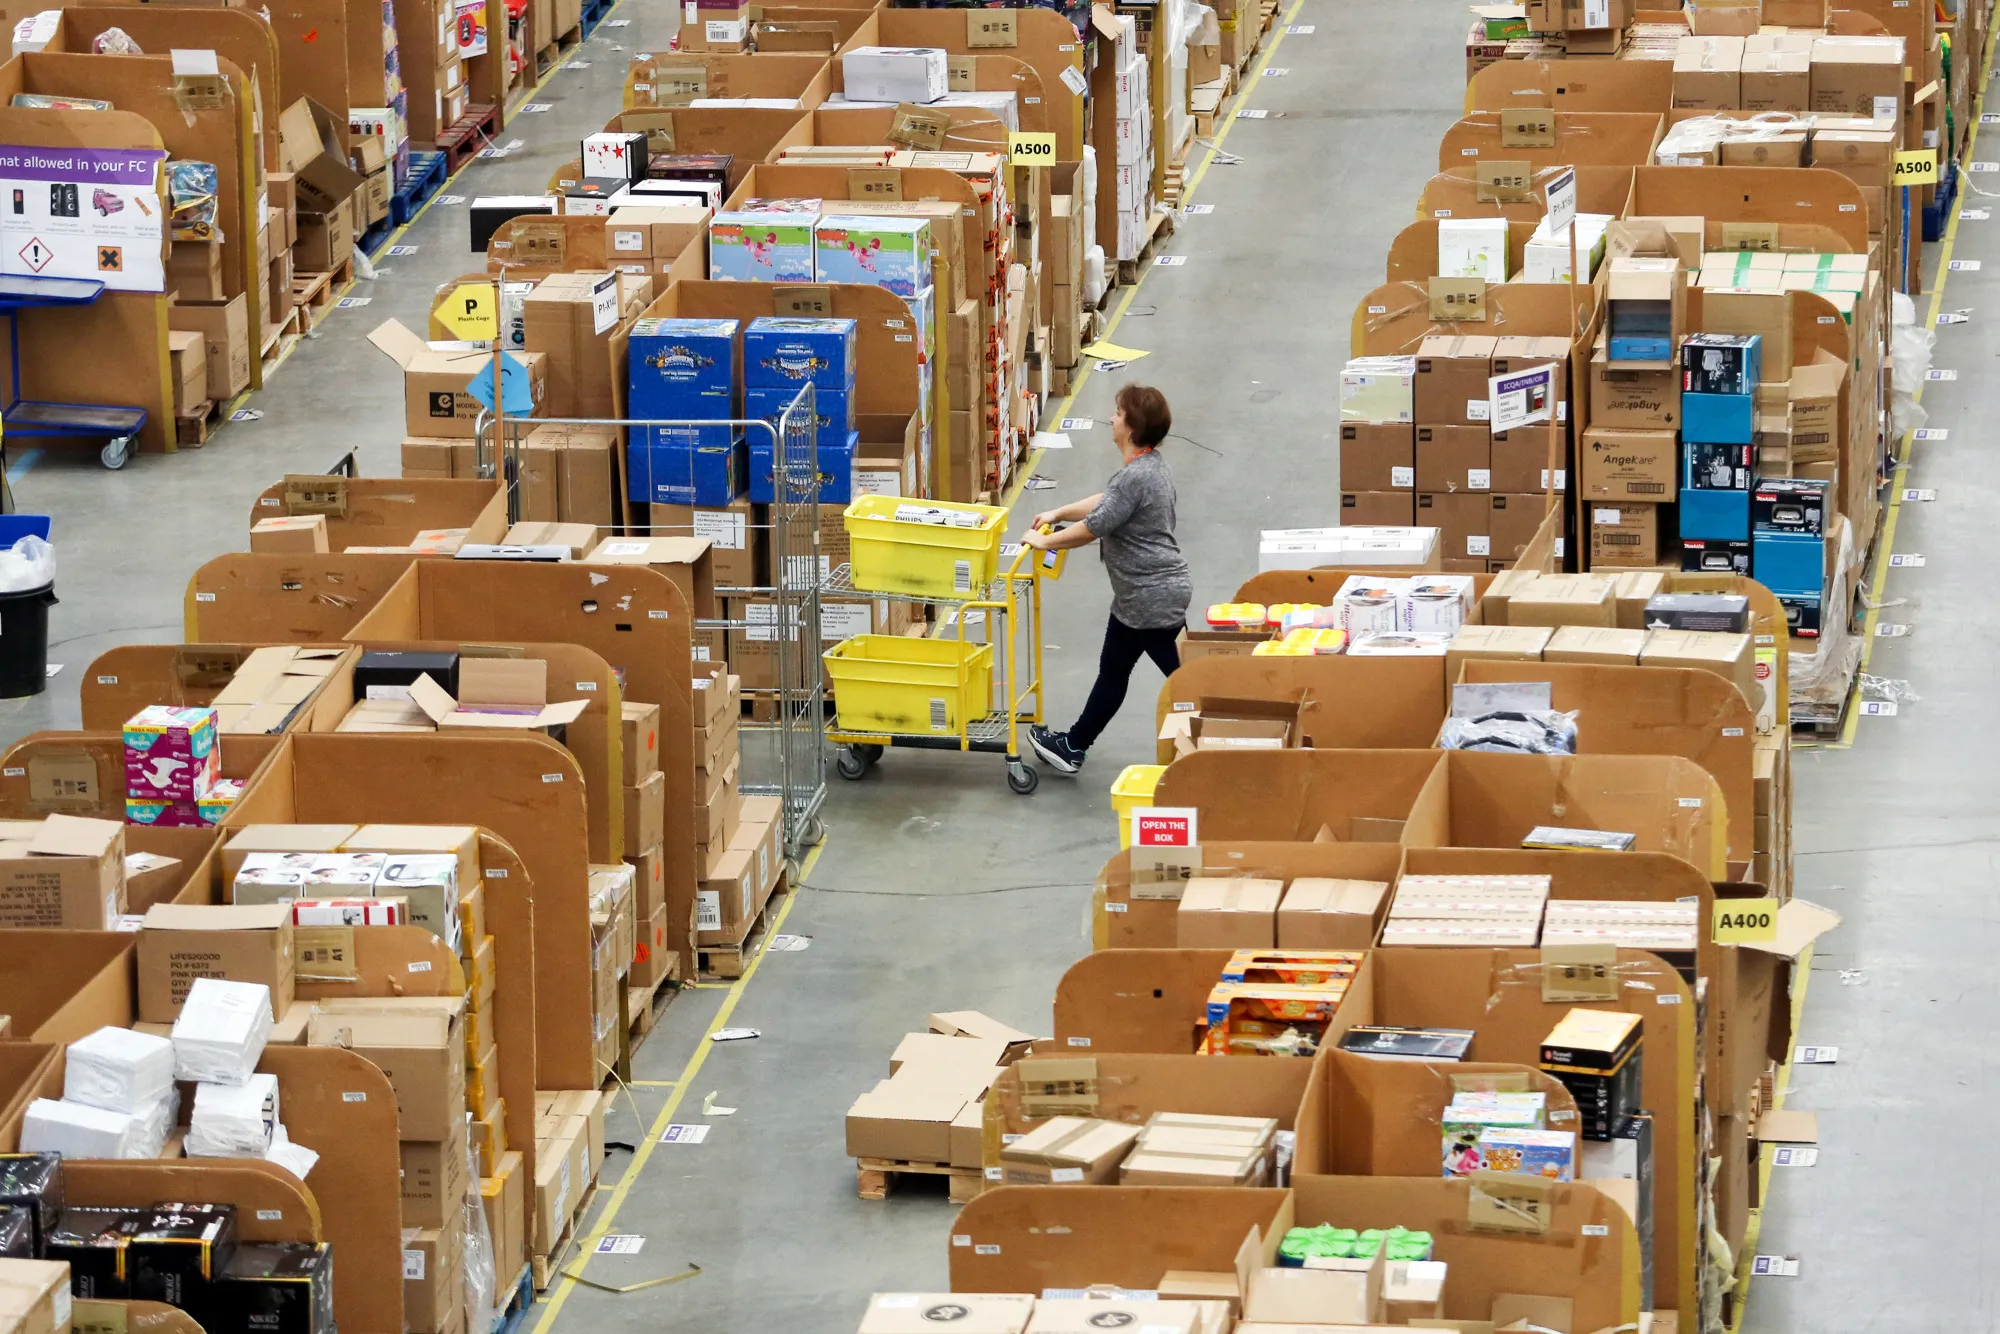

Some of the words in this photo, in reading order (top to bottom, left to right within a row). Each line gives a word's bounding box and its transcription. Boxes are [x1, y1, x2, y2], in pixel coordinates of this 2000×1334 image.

[1002, 23, 1009, 32] A1
[961, 70, 968, 79] A1
[692, 82, 699, 92] A1
[929, 126, 937, 136] A1
[1539, 124, 1546, 132] A1
[1014, 143, 1051, 155] A500
[24, 156, 73, 170] allowed
[77, 159, 89, 170] in
[93, 161, 124, 173] your
[129, 161, 147, 172] FC
[1895, 161, 1932, 174] A500
[1515, 177, 1522, 185] A1
[886, 183, 894, 192] A1
[1762, 240, 1769, 249] A1
[1469, 294, 1476, 304] A1
[465, 299, 478, 315] P
[814, 302, 822, 311] A1
[1603, 455, 1654, 466] Angelcare
[130, 738, 150, 746] Pampers
[78, 781, 87, 792] A1
[1142, 821, 1167, 829] OPEN
[1168, 821, 1186, 830] THE
[1154, 833, 1173, 842] BOX
[1181, 867, 1190, 878] A1
[1719, 913, 1770, 928] A400
[332, 949, 342, 960] A1
[1490, 1159, 1522, 1172] MOO
[1527, 1199, 1538, 1212] A1
[249, 1315, 280, 1323] NIKKO
